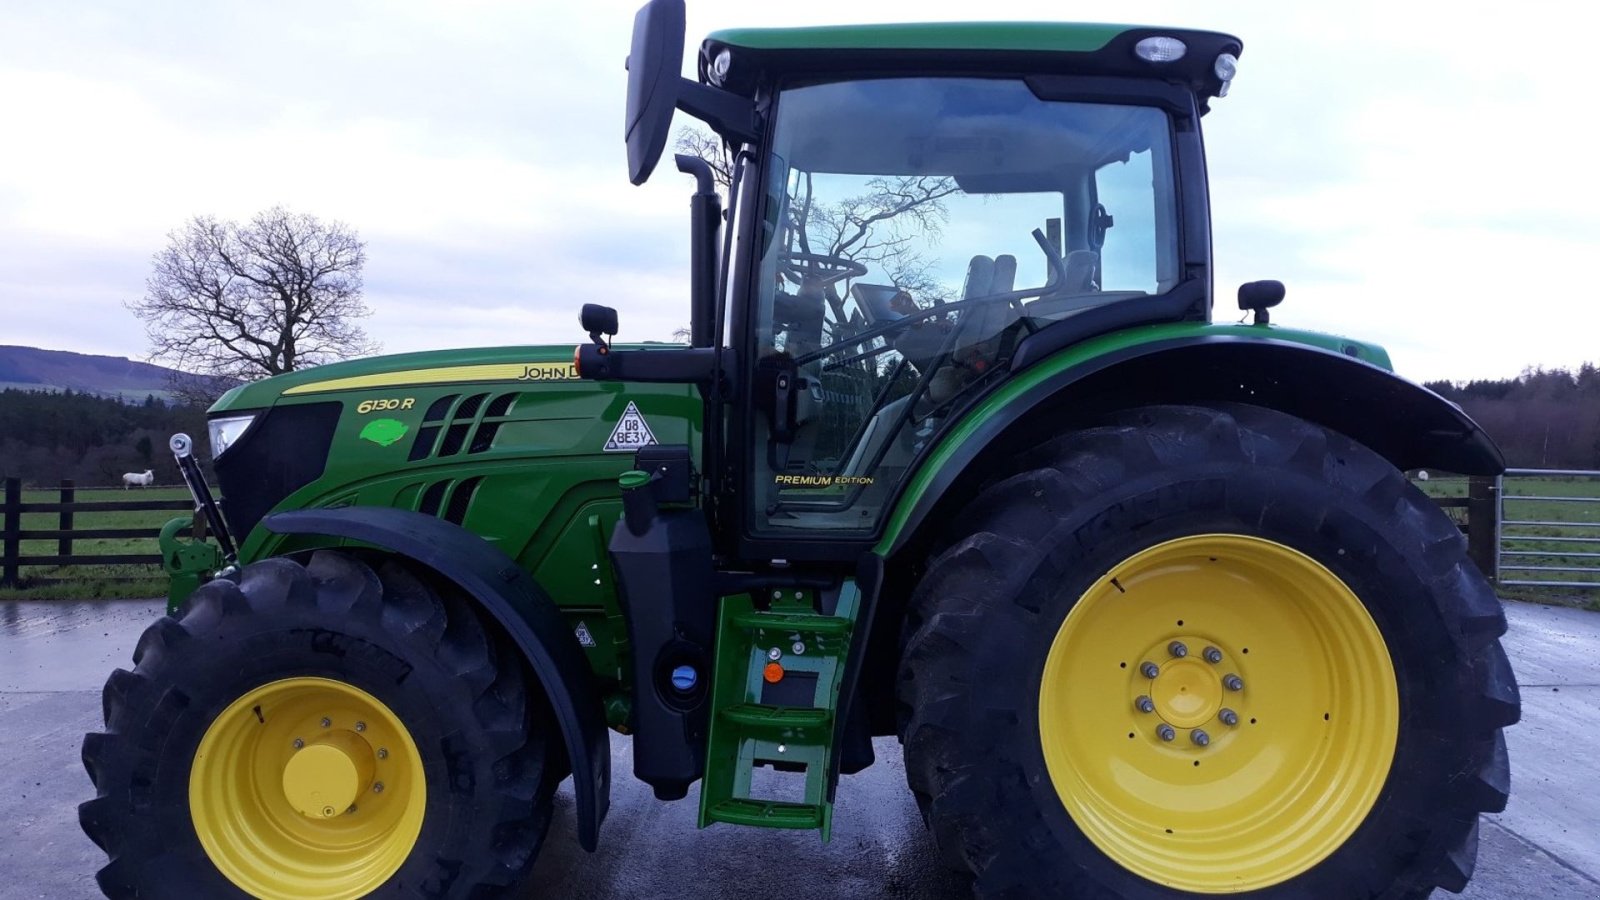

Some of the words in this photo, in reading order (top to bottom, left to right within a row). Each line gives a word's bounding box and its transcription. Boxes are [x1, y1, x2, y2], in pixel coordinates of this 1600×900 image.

[518, 365, 566, 379] JOHN
[616, 432, 647, 444] BE3Y
[775, 475, 832, 485] PREMIUM
[835, 476, 875, 484] EDITION
